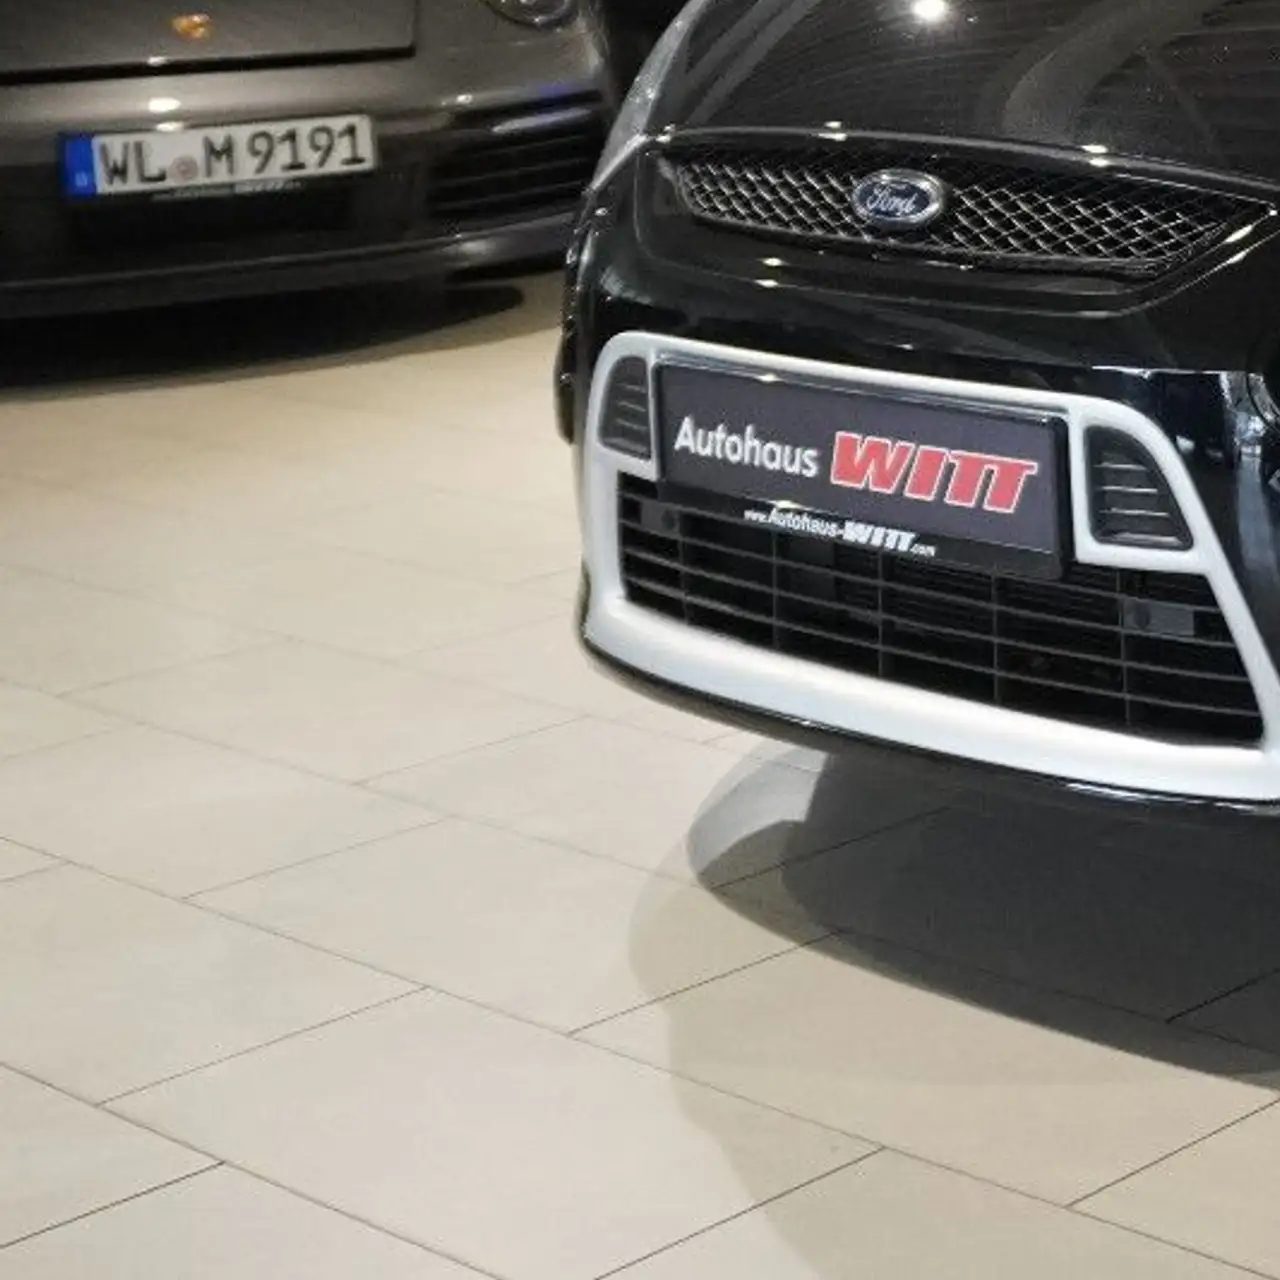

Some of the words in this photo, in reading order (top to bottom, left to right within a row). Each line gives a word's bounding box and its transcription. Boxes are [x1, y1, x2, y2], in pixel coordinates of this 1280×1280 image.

[100, 139, 167, 186] WL
[246, 122, 366, 175] 9191
[866, 186, 919, 214] Ford
[674, 416, 820, 478] Autohaus
[830, 431, 1038, 514] WITT
